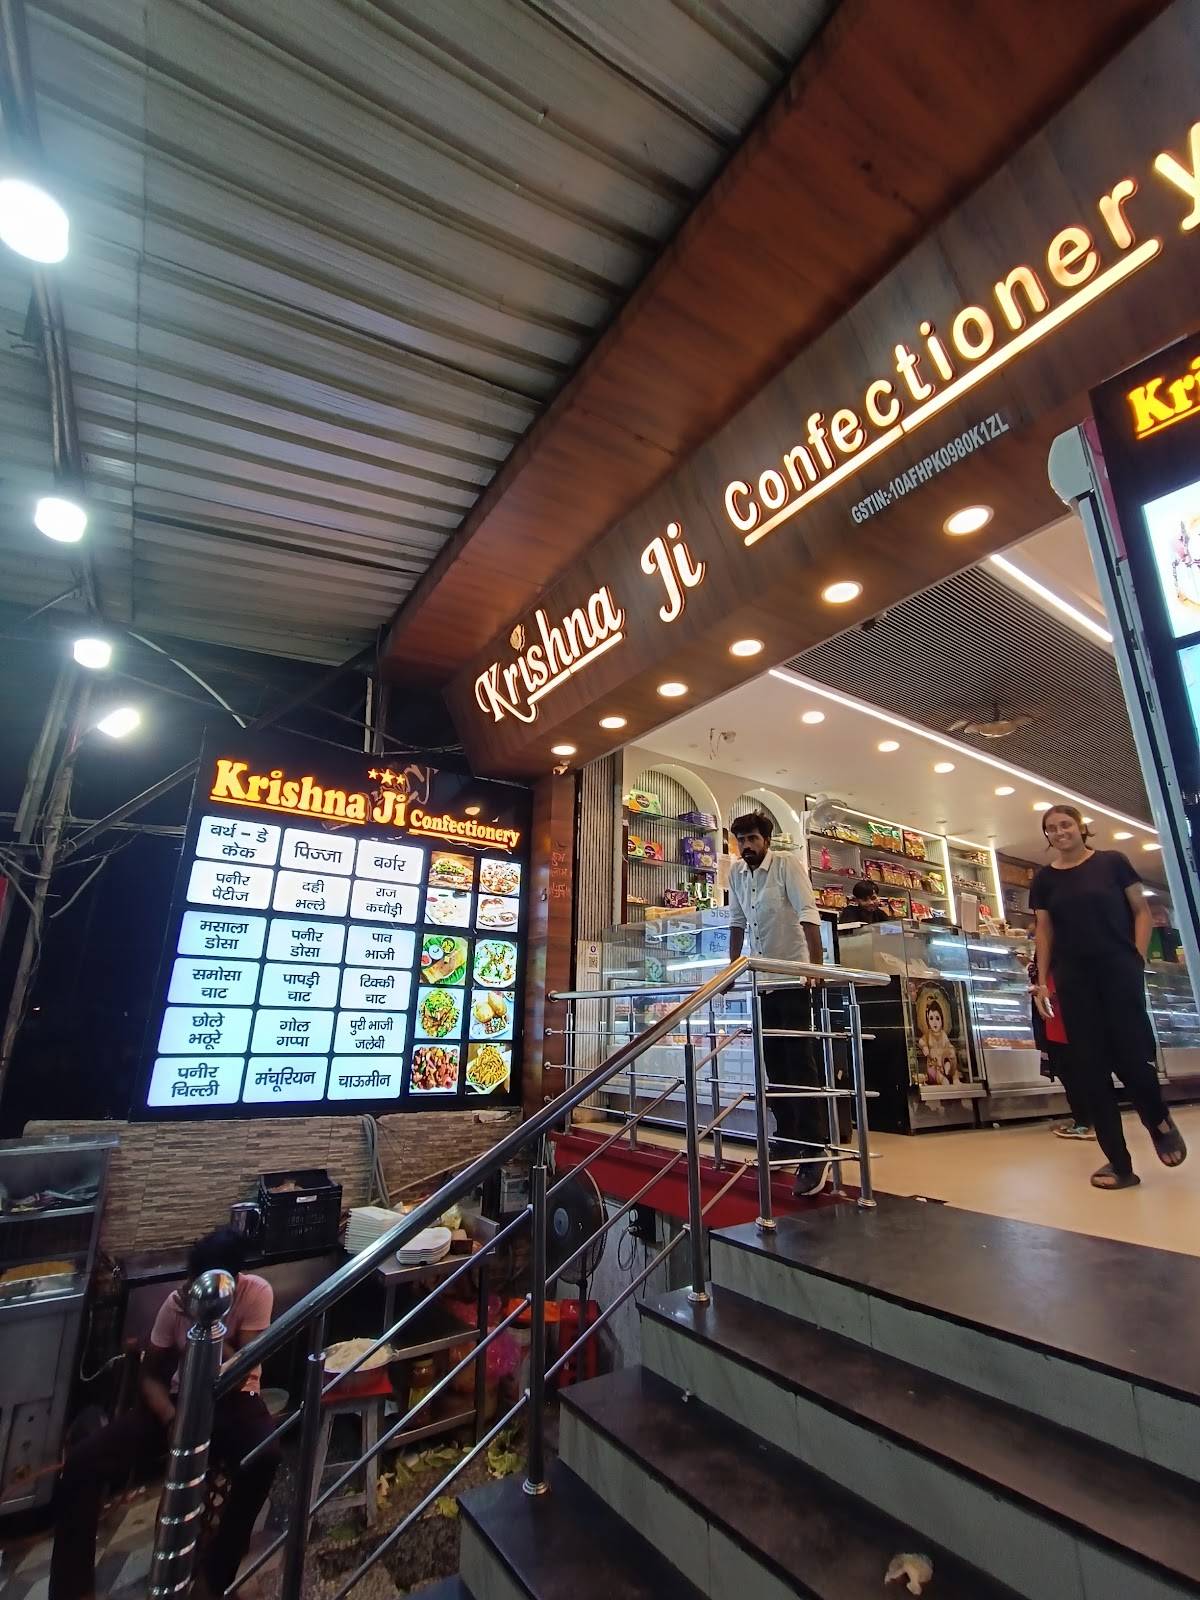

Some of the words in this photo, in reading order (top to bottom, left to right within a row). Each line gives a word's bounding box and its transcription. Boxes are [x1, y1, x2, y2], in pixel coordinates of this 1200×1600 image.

[475, 586, 625, 723] Krishna
[641, 522, 705, 623] Ji
[724, 118, 1200, 533] Confectionery
[211, 759, 366, 821] Krishna
[373, 790, 407, 827] Ji
[410, 809, 520, 848] Confectionery
[256, 828, 269, 843] डे
[222, 842, 257, 858] केक
[293, 841, 342, 864] पिज्जा
[216, 871, 251, 886] पनीर
[302, 880, 325, 893] दही
[212, 885, 250, 902] पैटीज
[375, 887, 397, 899] राज
[295, 898, 326, 911] भल्ले
[200, 920, 249, 934] मसाला
[291, 927, 324, 942] पनीर
[204, 934, 239, 950] डोसा
[372, 932, 393, 943] पाव
[290, 943, 320, 958] डोसा
[365, 947, 395, 961] भाजी
[192, 966, 242, 982] समोसा
[283, 971, 320, 988] पापड़ी
[360, 973, 395, 989] टिक्की
[201, 987, 229, 999] चाट
[288, 991, 312, 1002] चाट
[365, 994, 387, 1005] चाट
[192, 1012, 226, 1028] छोले
[280, 1017, 311, 1032] गोल
[350, 1016, 366, 1036] पुरी
[368, 1016, 393, 1031] भाजी
[188, 1029, 223, 1050] भठूरे
[276, 1036, 310, 1048] गप्पा
[177, 1062, 220, 1079] पनीर
[338, 1069, 391, 1088] चाऊमीन
[255, 1066, 316, 1092] मंचूरियन
[171, 1080, 220, 1098] चिल्ली
